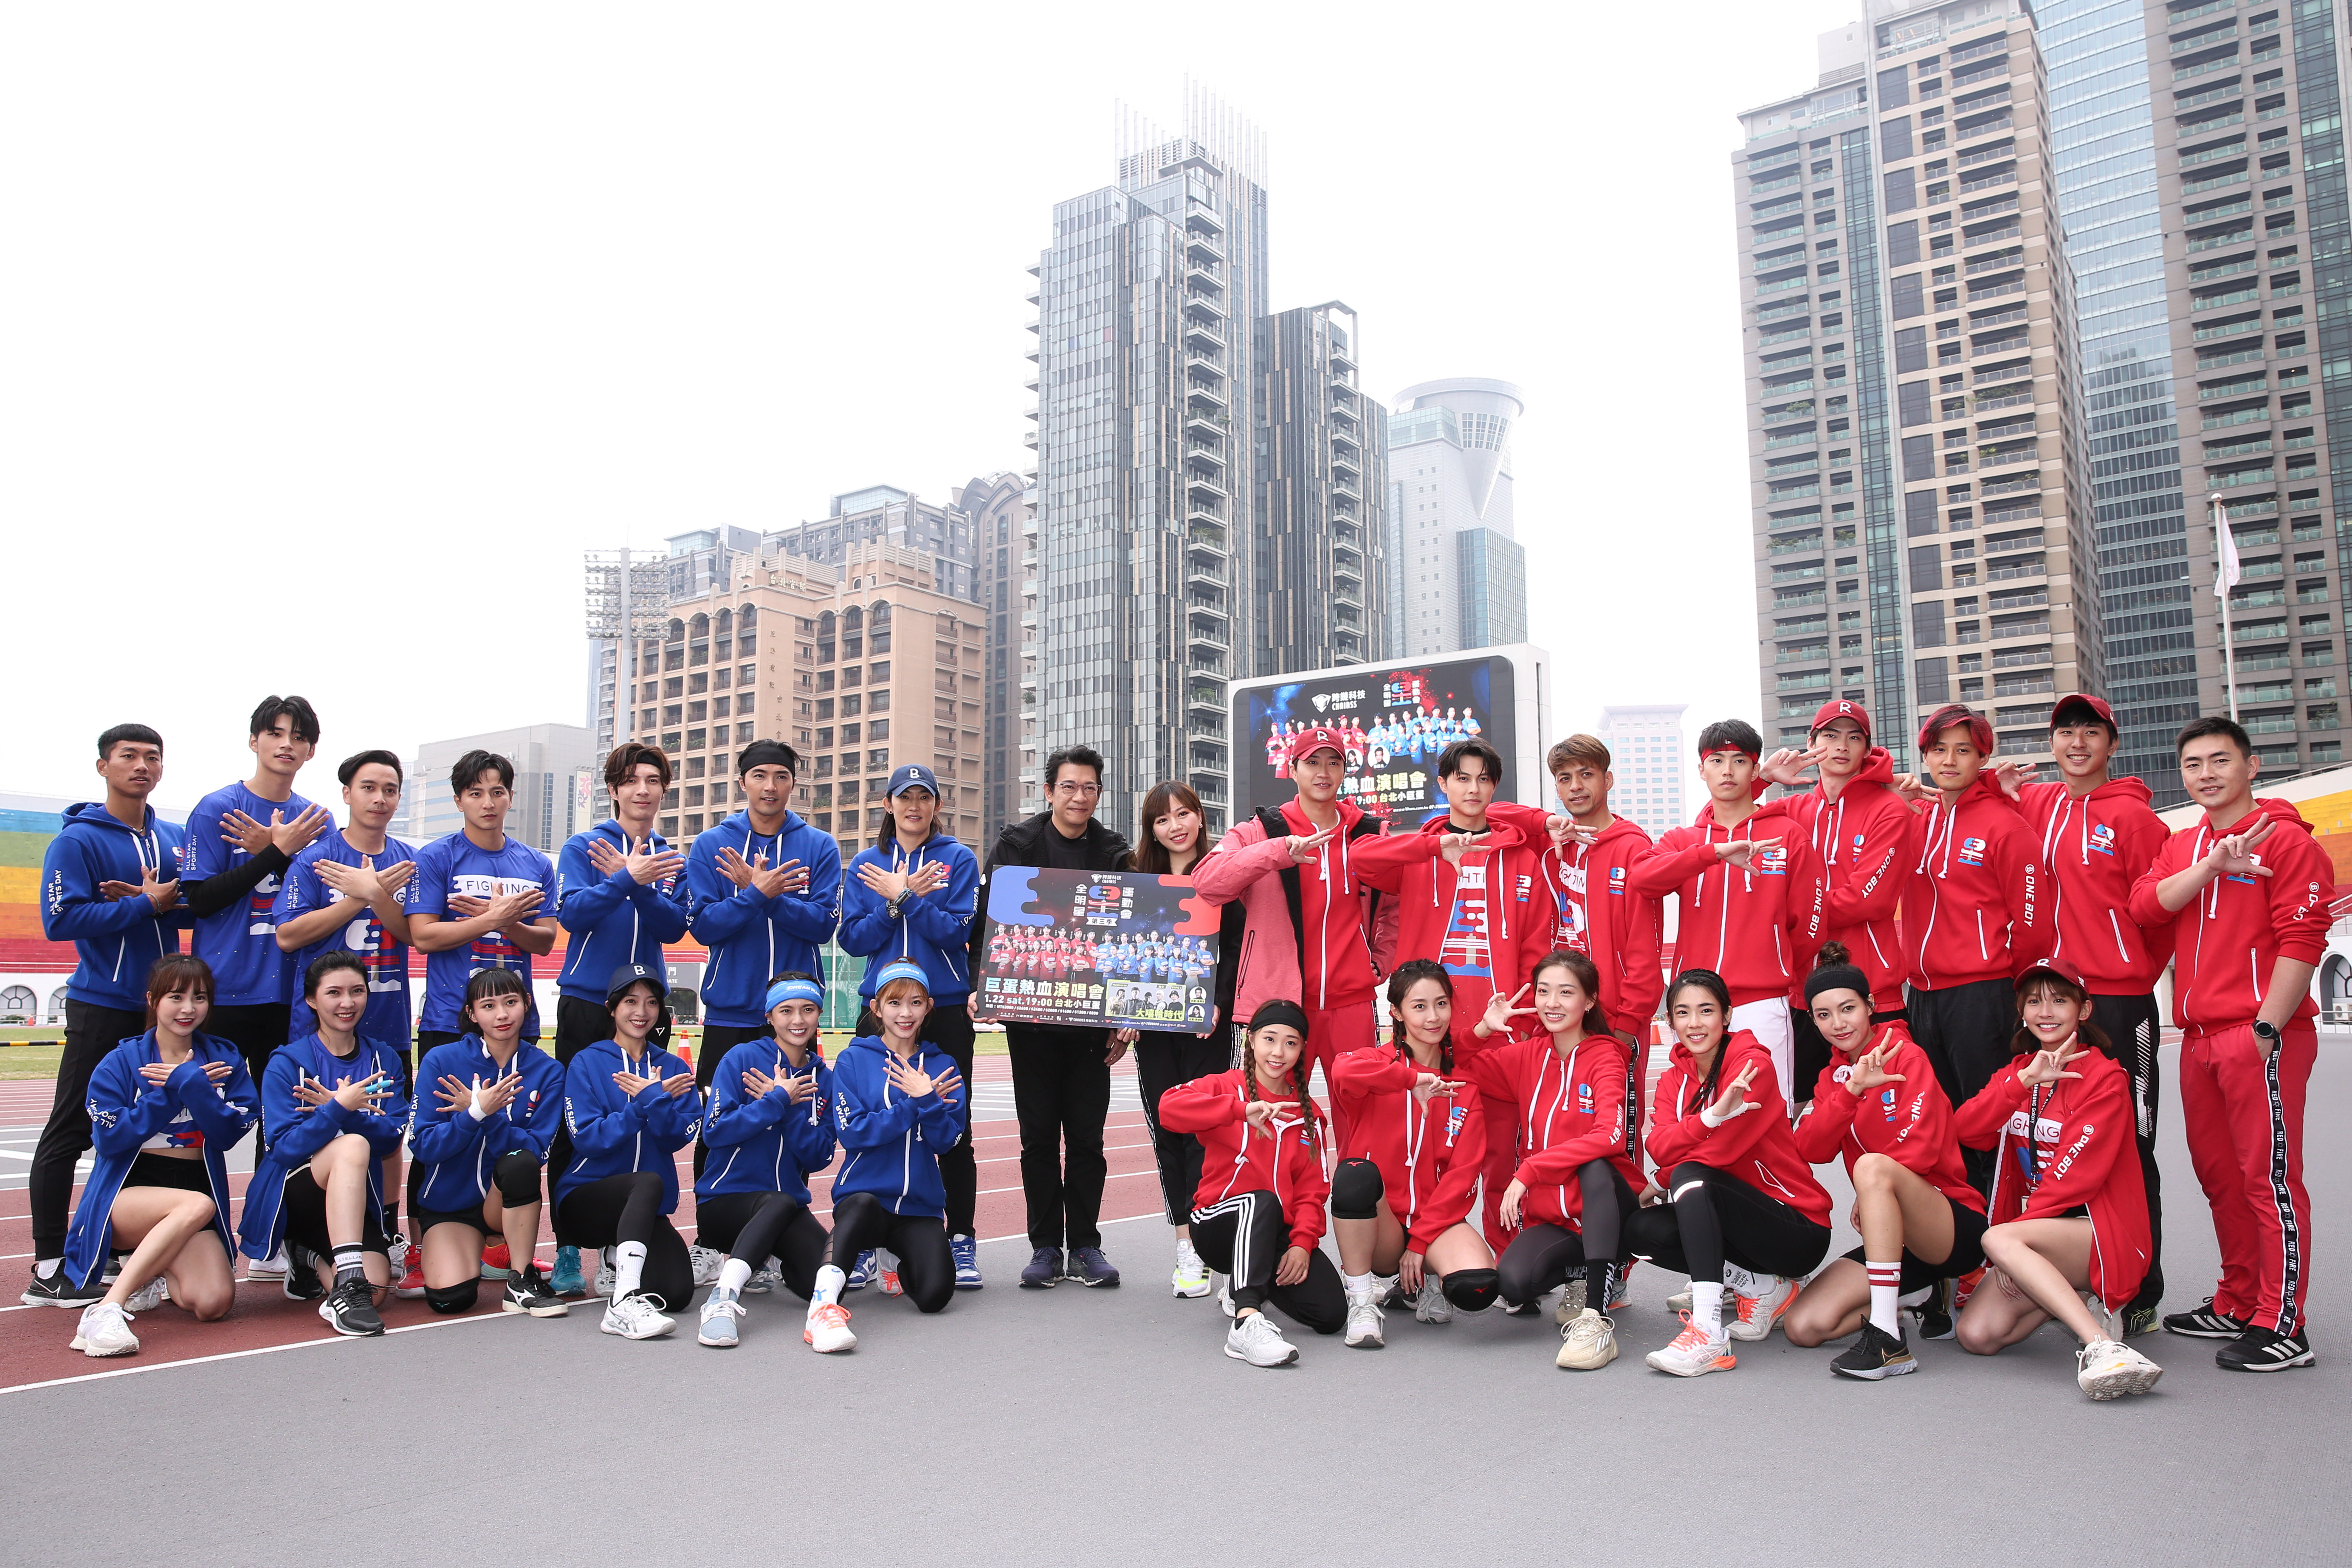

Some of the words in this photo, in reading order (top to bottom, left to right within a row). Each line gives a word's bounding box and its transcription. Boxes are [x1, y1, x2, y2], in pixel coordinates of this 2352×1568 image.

[1331, 689, 1366, 702] 跨鏈科技
[1839, 702, 1851, 713] R
[1317, 730, 1329, 742] R
[910, 768, 920, 778] B
[1379, 790, 1424, 803] 台北小巨蛋
[1876, 855, 1891, 879] ONE
[1861, 875, 1878, 899] BOY
[2025, 875, 2035, 902] ONE
[1073, 884, 1088, 917] 全明星
[1120, 887, 1134, 919] 運動會
[1813, 888, 1822, 914] ONE
[2024, 902, 2034, 928] BOY
[1808, 914, 1820, 939] BOY
[2036, 958, 2050, 967] R
[634, 965, 646, 975] B
[668, 967, 677, 976] 門
[985, 977, 1105, 1000] 巨蛋熱血演唱會
[984, 994, 1004, 1004] 1.22
[1055, 998, 1101, 1010] 台北小巨蛋
[565, 1097, 573, 1110] DAY
[838, 1092, 847, 1106] DAY
[101, 1118, 115, 1128] ALL
[1609, 1126, 1622, 1145] BOY
[2068, 1135, 2090, 1159] ONE
[2053, 1155, 2073, 1181] BOY
[2276, 1183, 2287, 1196] FIRE
[2280, 1202, 2291, 1213] RED
[2284, 1220, 2295, 1232] FIRE
[1619, 1262, 1627, 1271] FIRE
[2288, 1258, 2296, 1272] FIRE
[2287, 1279, 2296, 1291] RED
